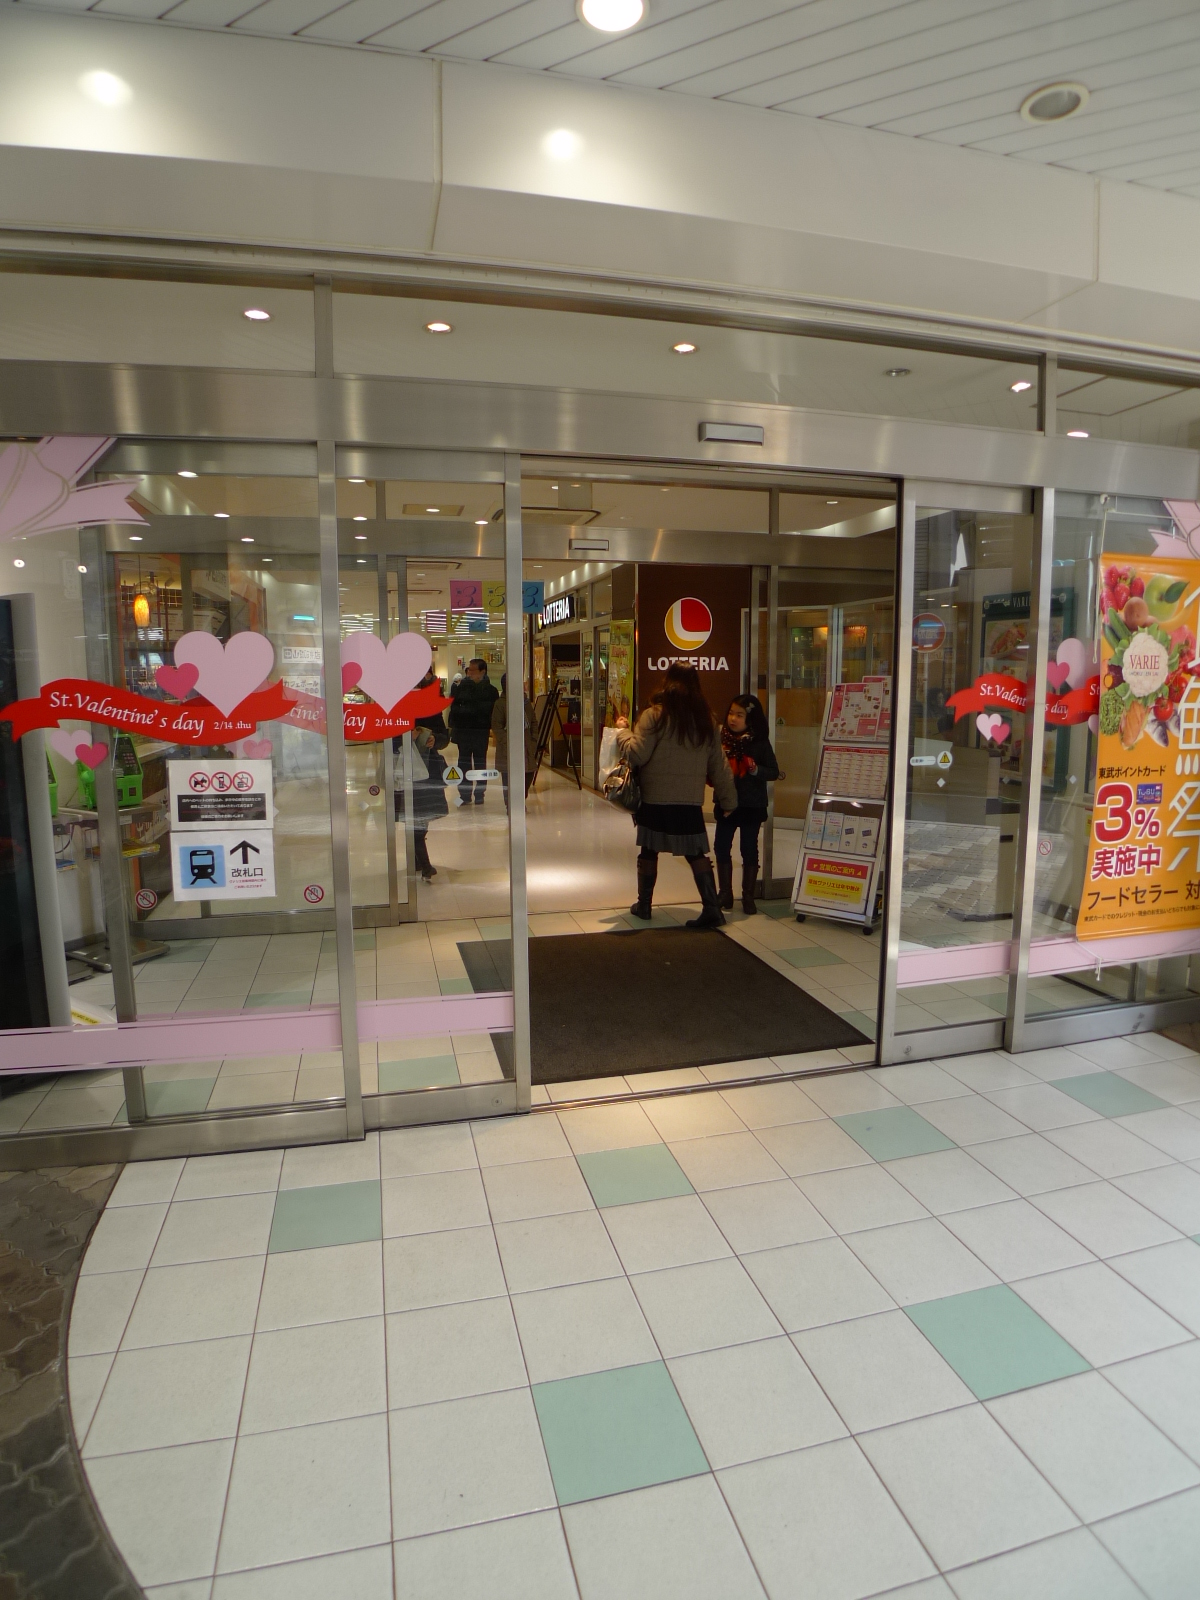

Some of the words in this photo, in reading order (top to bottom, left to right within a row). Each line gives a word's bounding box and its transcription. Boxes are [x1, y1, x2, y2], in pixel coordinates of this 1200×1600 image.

[544, 597, 570, 625] LOTTERIA
[1129, 654, 1160, 670] VARIE
[172, 711, 205, 738] day
[213, 721, 234, 730] 2/14
[375, 718, 393, 727] 2/14
[1098, 765, 1167, 780] 東武ポイントカード
[231, 867, 264, 878] 改札口
[1091, 843, 1162, 881] 実施中
[1087, 884, 1179, 911] フードセラー
